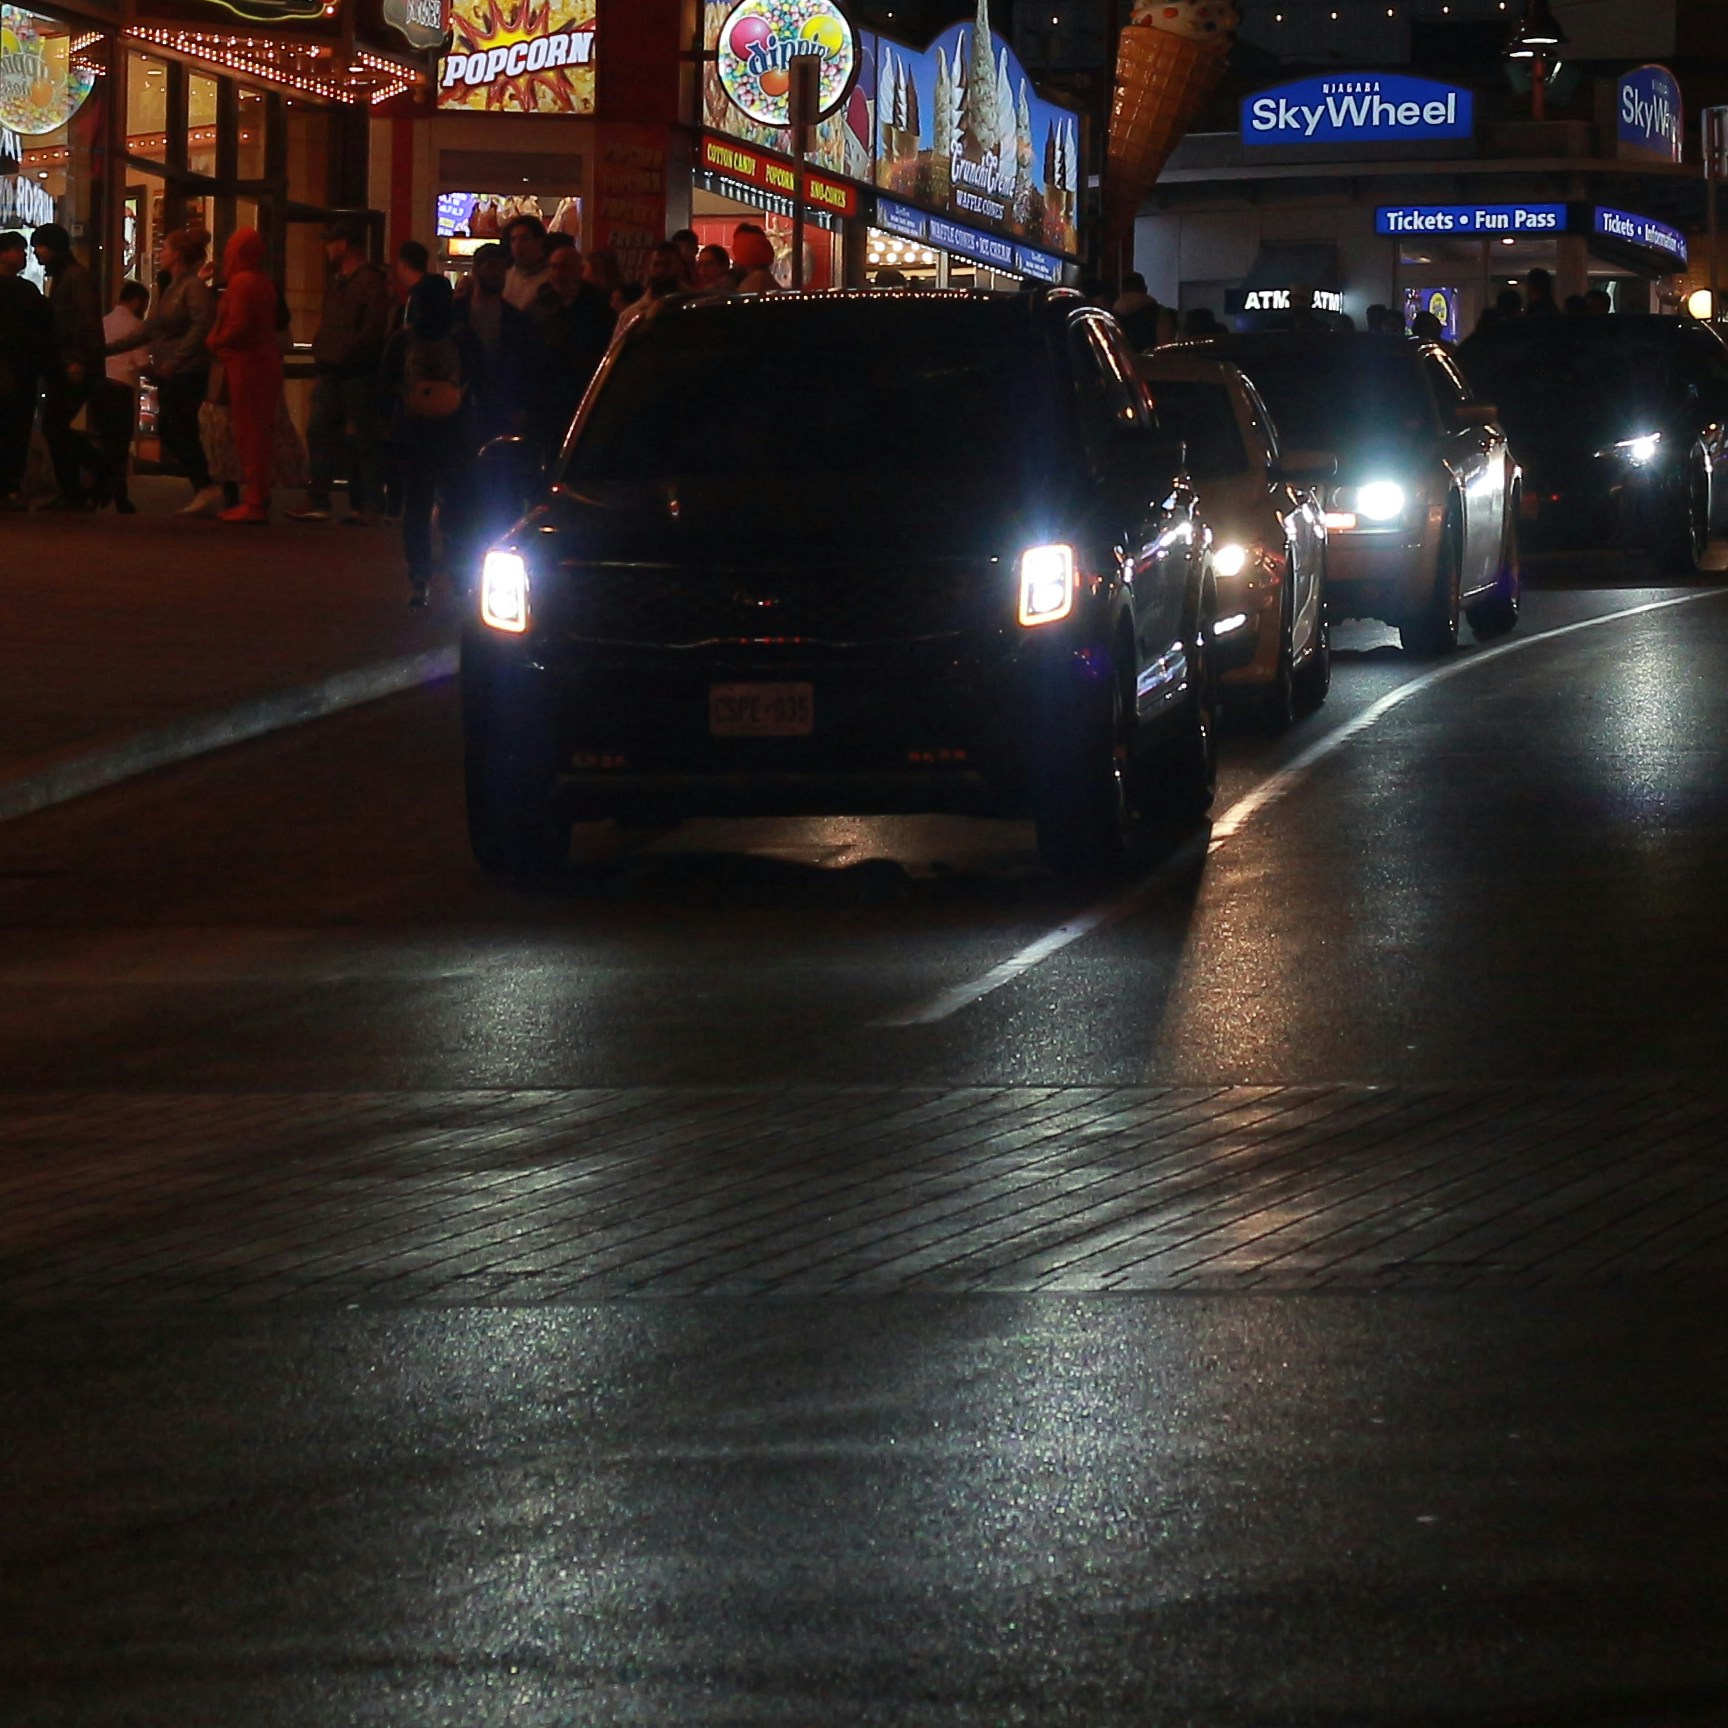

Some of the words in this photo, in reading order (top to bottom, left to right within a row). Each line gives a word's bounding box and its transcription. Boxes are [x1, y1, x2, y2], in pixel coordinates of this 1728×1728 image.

[442, 31, 595, 87] POPCORN
[1322, 81, 1381, 93] NIAGARA
[1251, 91, 1457, 137] SkyWheel
[706, 142, 733, 166] COTTON
[733, 151, 757, 177] CANDY
[765, 163, 795, 192] POPCORN
[810, 180, 847, 209] SNO-CONES
[955, 188, 983, 214] WAFFLE
[983, 198, 1006, 221] CONES
[1386, 211, 1454, 232] Tickets
[1475, 210, 1511, 229] Fun
[1514, 209, 1557, 229] Pass
[1602, 212, 1635, 238] Tickets
[929, 219, 956, 245] WAFFLE
[955, 229, 976, 251] CONES
[978, 236, 990, 257] ICE
[990, 240, 1012, 264] CREAM
[1243, 290, 1292, 310] ATM
[1311, 289, 1341, 313] ATM
